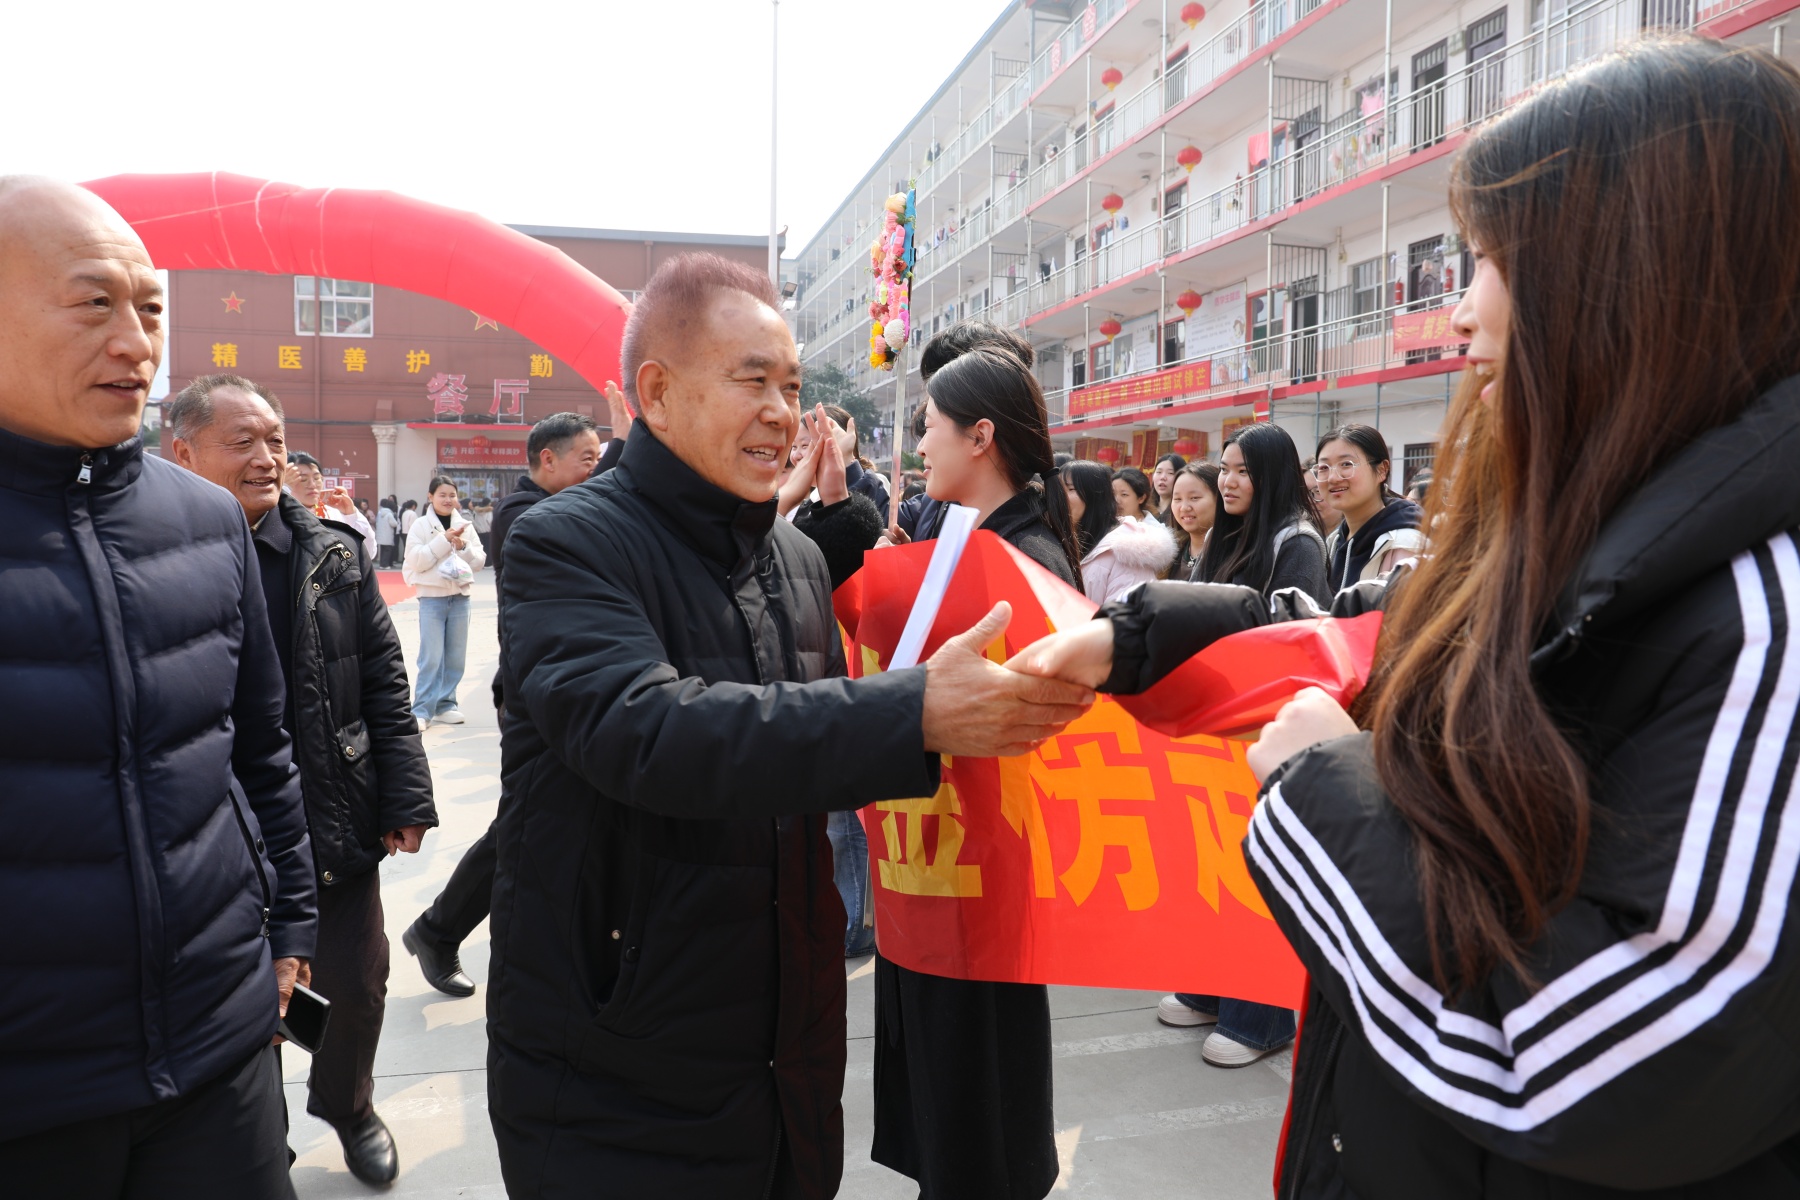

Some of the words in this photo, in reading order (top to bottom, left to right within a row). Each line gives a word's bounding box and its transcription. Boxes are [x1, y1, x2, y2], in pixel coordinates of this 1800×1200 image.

[211, 342, 431, 374] 精医善护
[530, 354, 553, 378] 勤
[426, 372, 530, 416] 餐厅
